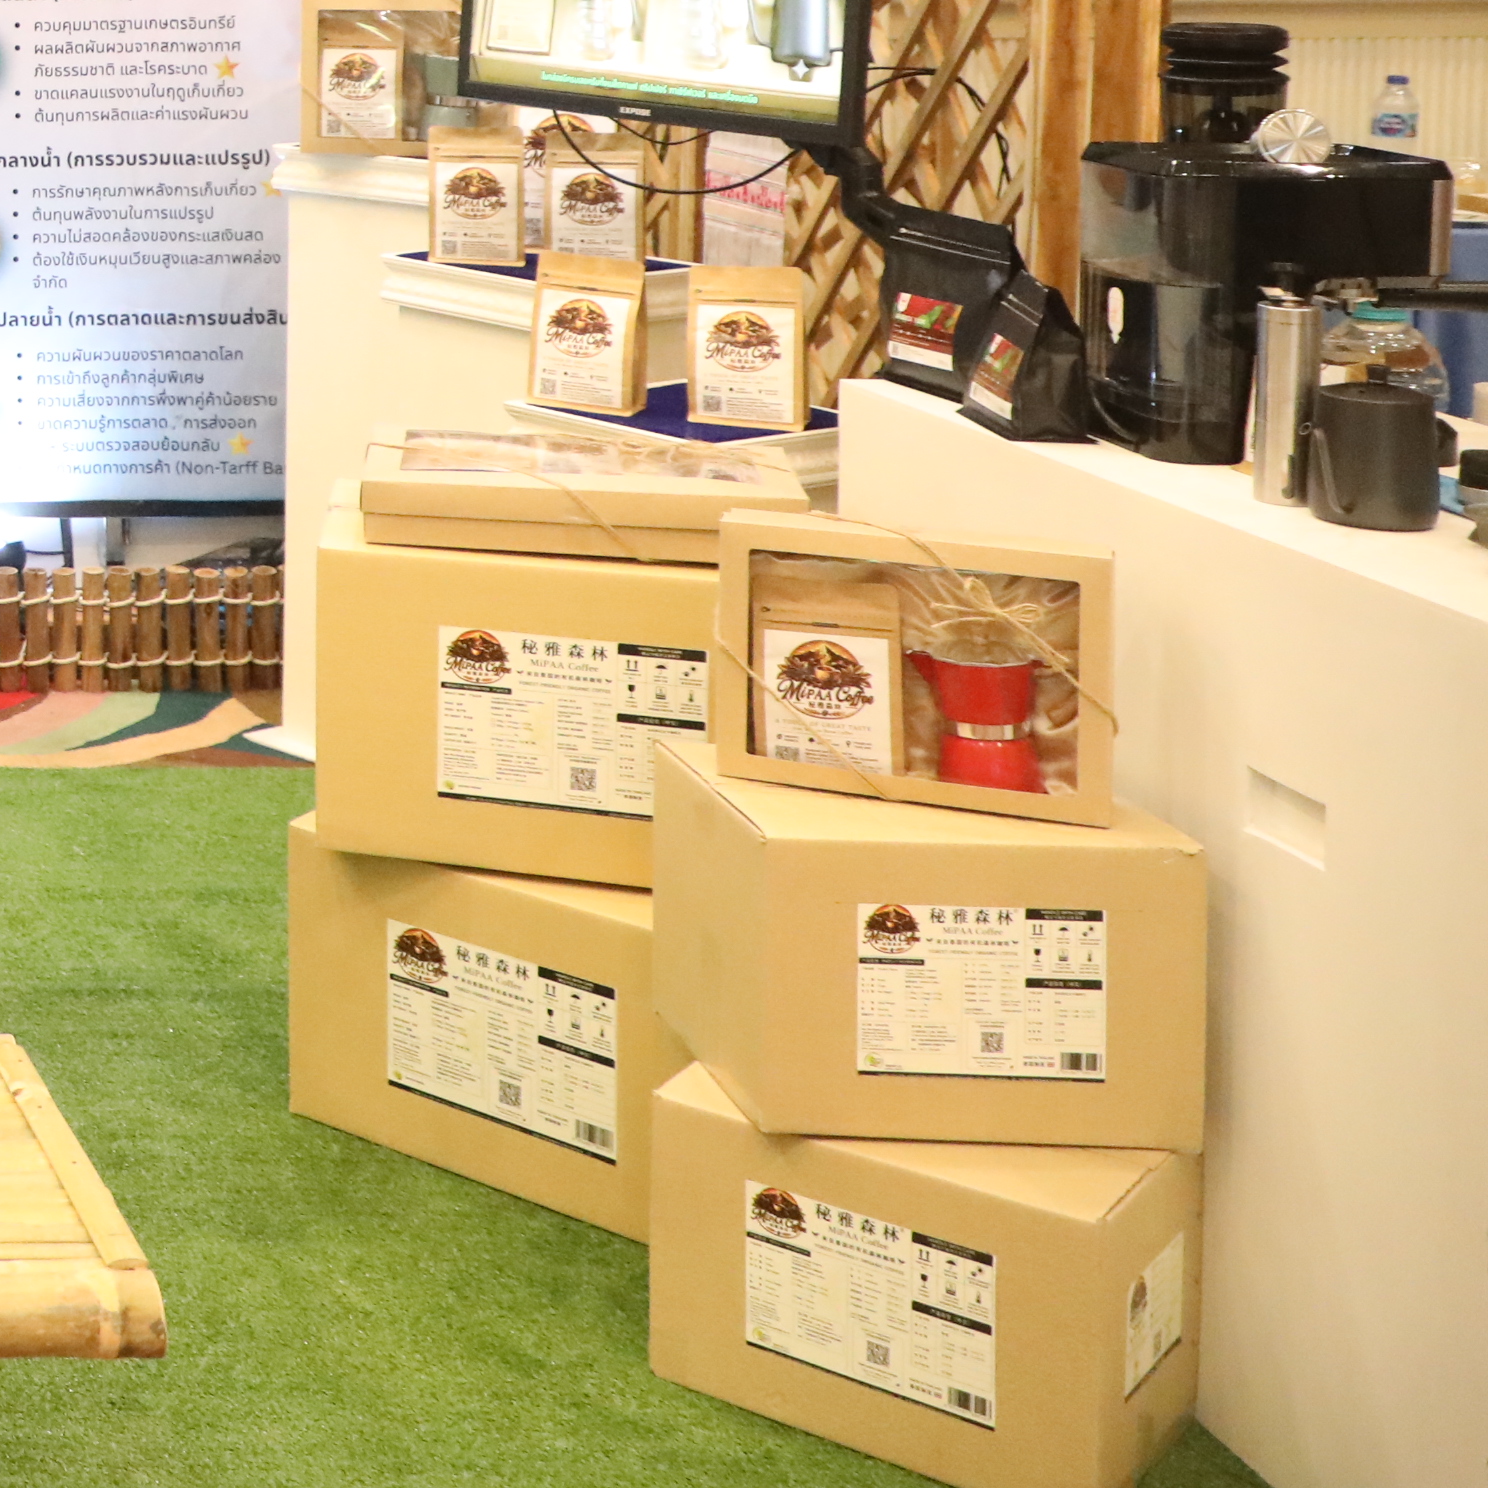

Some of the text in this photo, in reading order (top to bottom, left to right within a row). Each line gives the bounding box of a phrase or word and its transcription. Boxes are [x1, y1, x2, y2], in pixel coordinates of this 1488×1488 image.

[521, 638, 609, 662] 秘雅森林
[530, 658, 599, 673] MiPAA Coffee
[929, 907, 1014, 926] 秘雅森林
